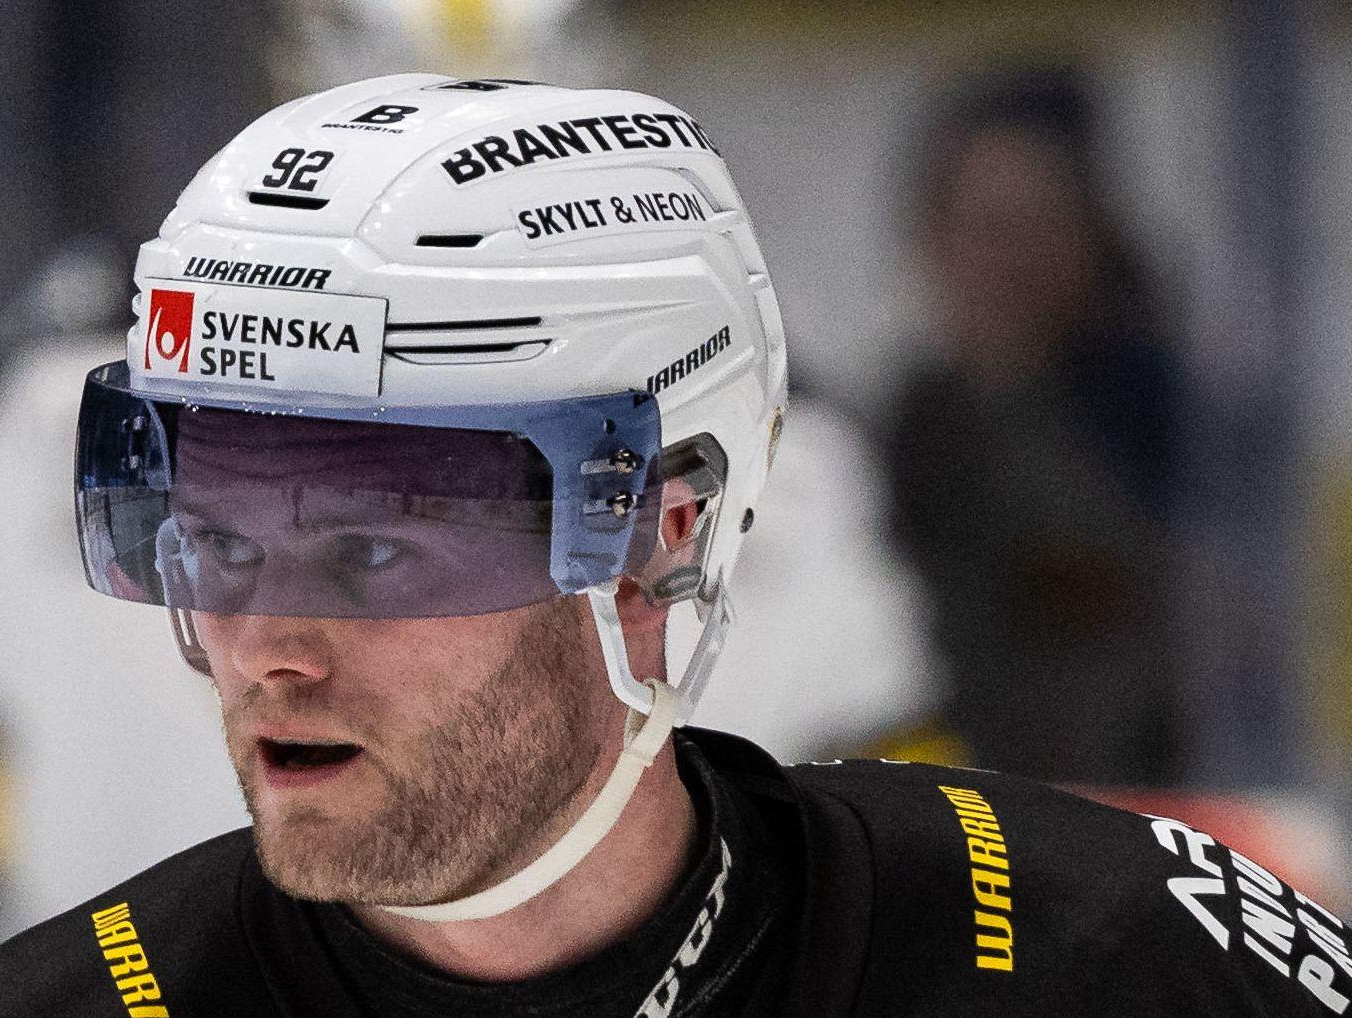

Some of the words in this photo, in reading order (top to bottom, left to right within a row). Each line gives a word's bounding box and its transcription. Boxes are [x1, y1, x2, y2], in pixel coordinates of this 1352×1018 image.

[262, 148, 335, 192] 92
[518, 198, 608, 240] SKYLT
[610, 195, 633, 224] &
[636, 192, 706, 223] NEON
[183, 256, 332, 290] WARRIOR
[201, 310, 360, 354] SVENSKA
[200, 346, 276, 381] SPEL
[937, 784, 1014, 973] WARRIOR
